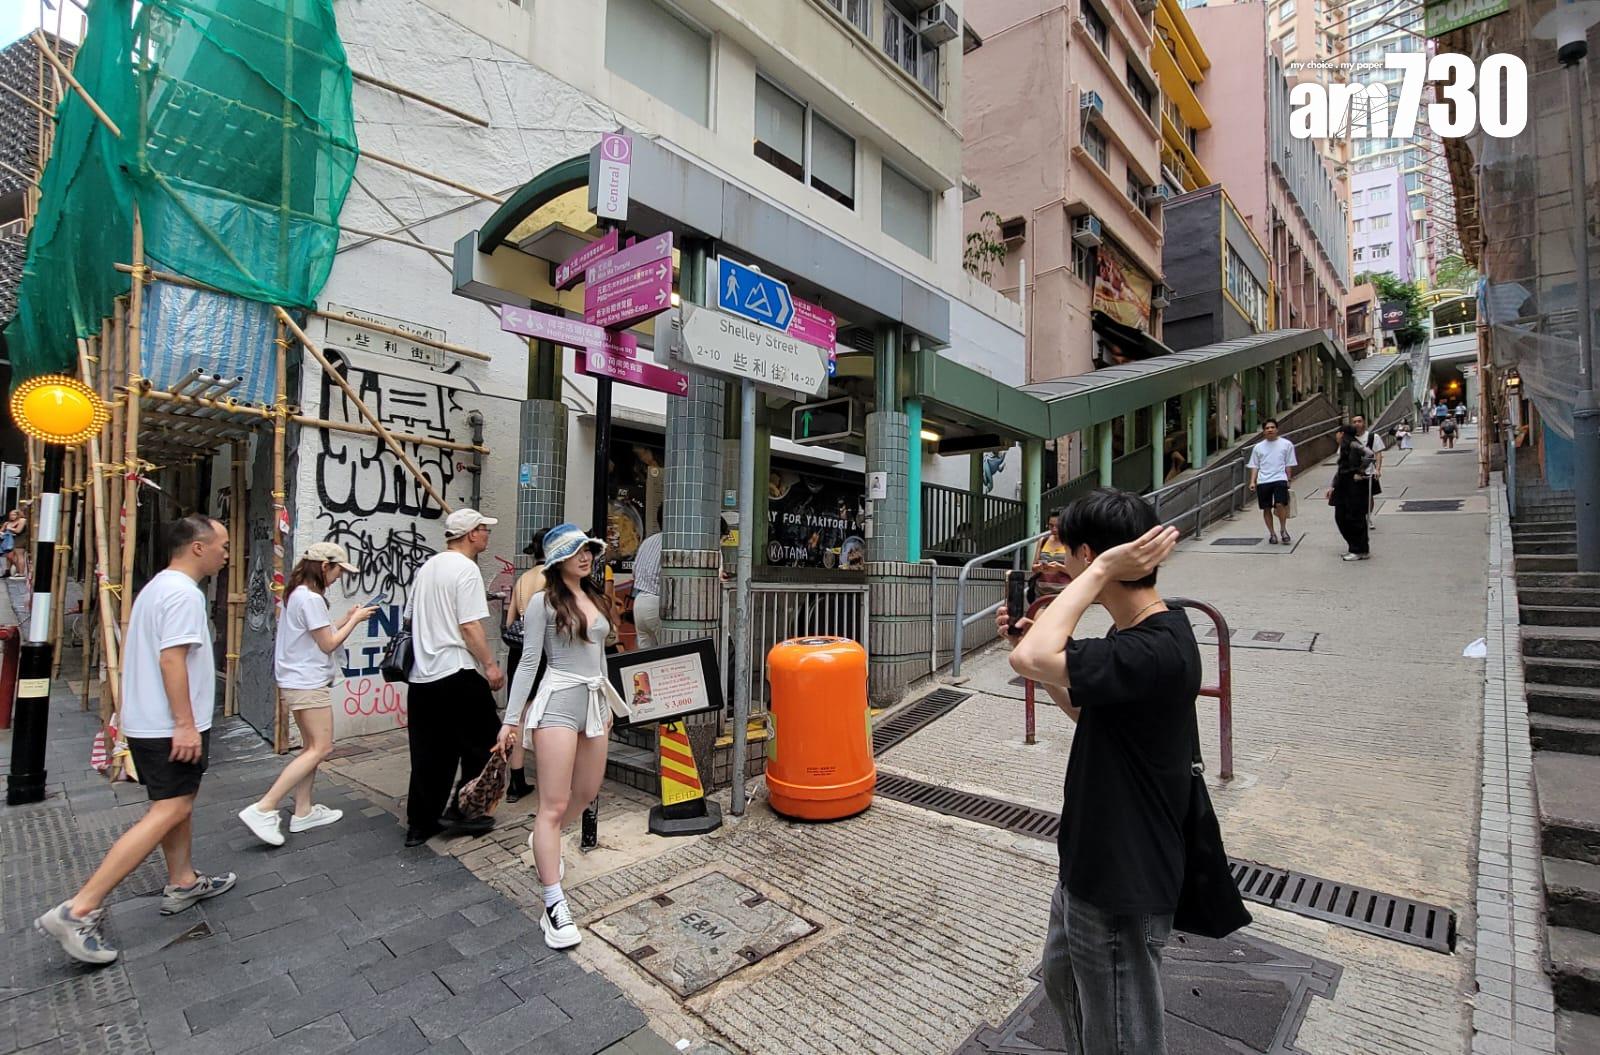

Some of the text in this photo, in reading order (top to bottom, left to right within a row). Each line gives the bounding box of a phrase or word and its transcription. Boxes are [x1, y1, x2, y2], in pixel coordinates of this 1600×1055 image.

[607, 167, 620, 212] Central
[355, 333, 423, 359] 些利街
[719, 319, 800, 356] Shelley Street
[733, 351, 787, 383] 些利街
[783, 513, 802, 525] FOR
[806, 515, 848, 529] YAKITORI
[679, 912, 727, 941] E&M
